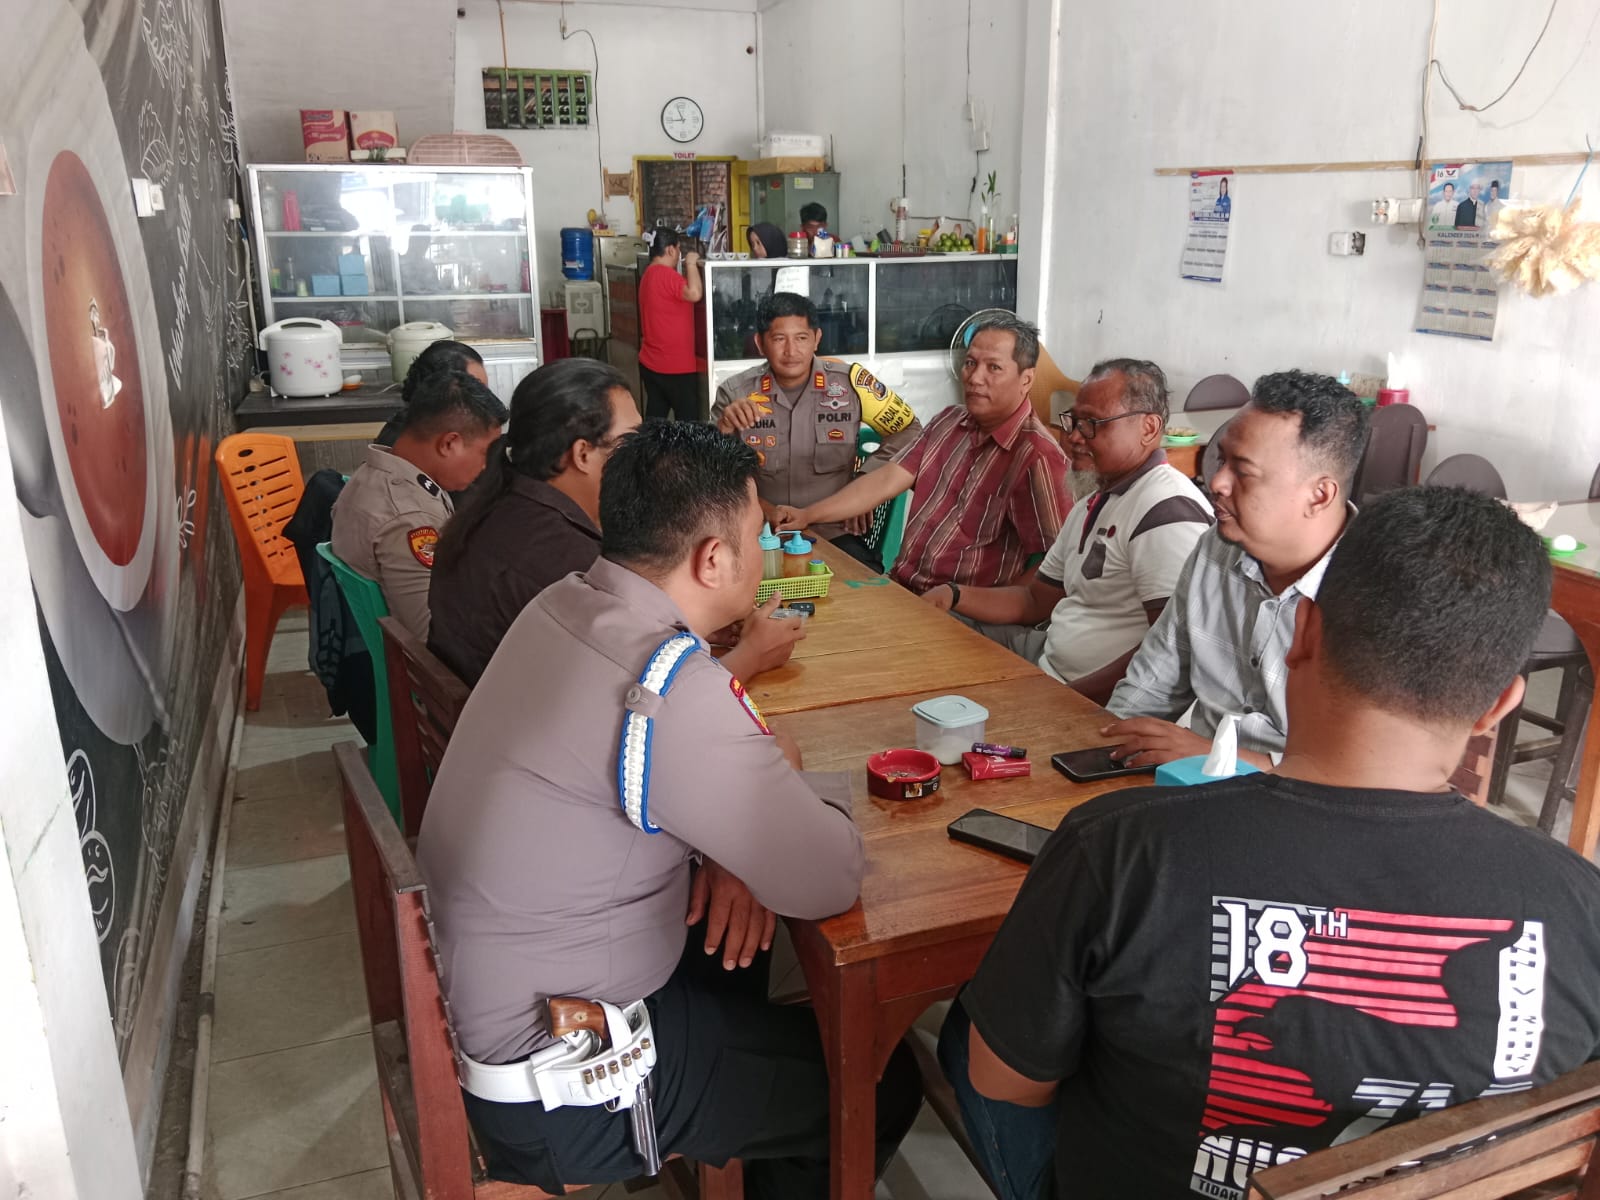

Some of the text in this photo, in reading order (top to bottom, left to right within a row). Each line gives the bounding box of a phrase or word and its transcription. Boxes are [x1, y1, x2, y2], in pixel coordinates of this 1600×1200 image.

[818, 413, 851, 423] POLRI
[879, 405, 899, 426] PADAL
[1199, 1179, 1239, 1200] TIDAK
